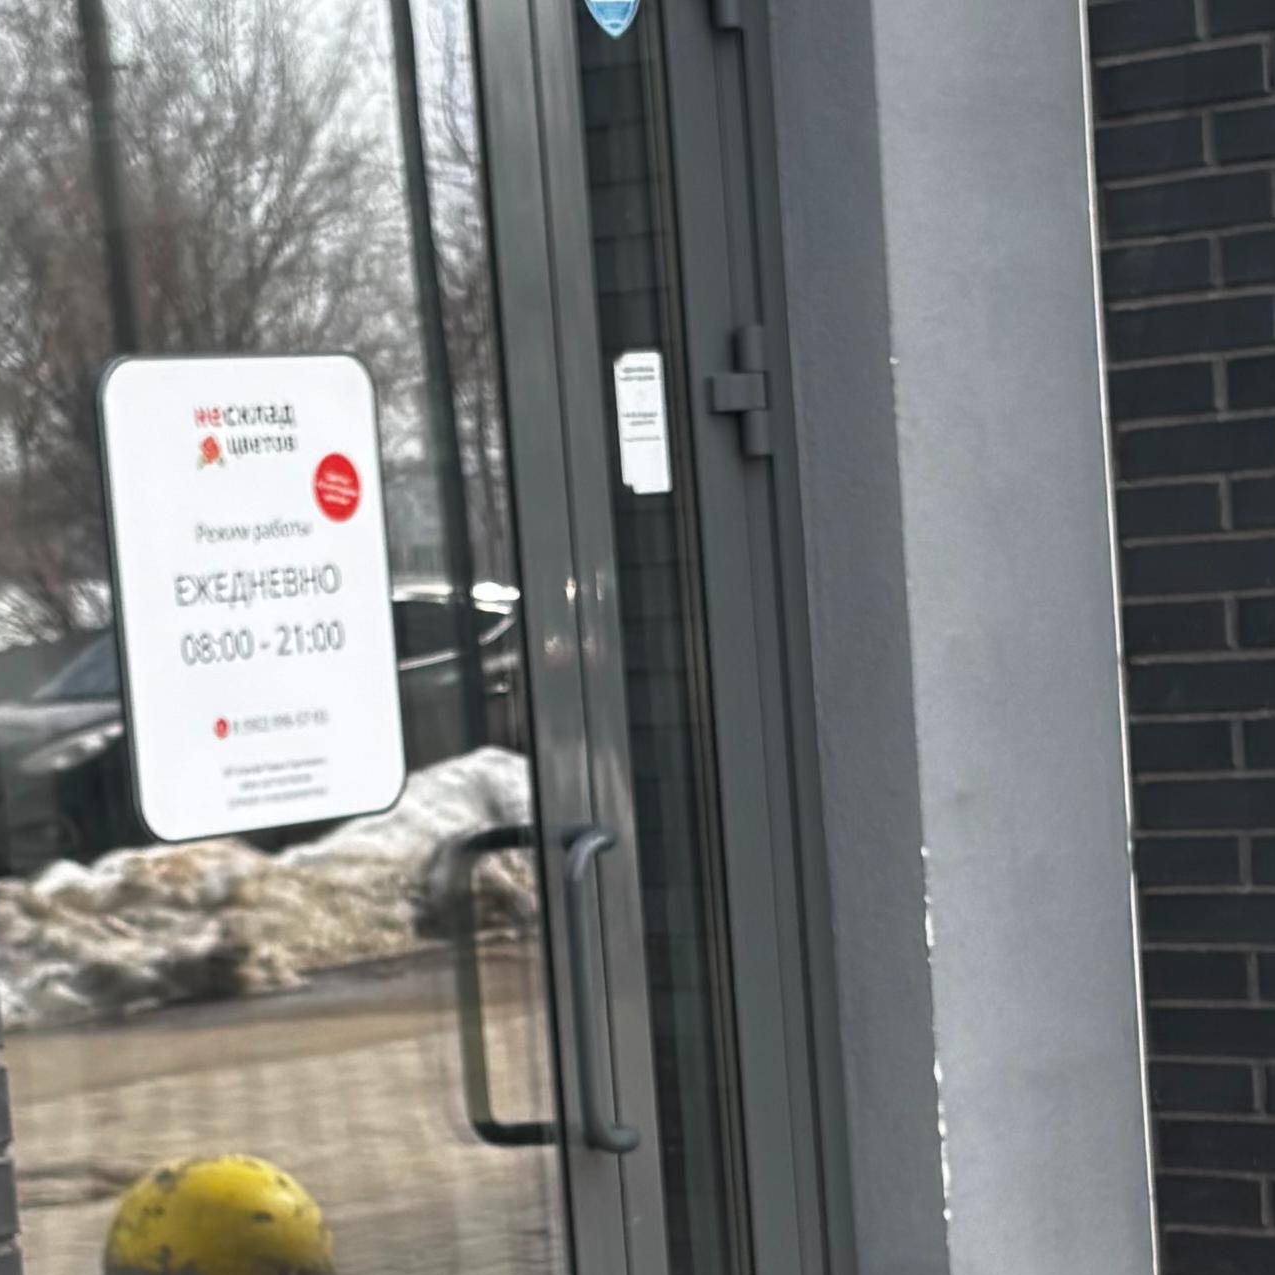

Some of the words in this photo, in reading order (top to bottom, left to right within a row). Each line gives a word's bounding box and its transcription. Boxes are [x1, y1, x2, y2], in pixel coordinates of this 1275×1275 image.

[196, 523, 249, 543] Режим
[252, 518, 313, 545] работы
[175, 564, 342, 608] ЕЖЕДНЕВНО
[181, 629, 255, 665] 08:00
[276, 620, 345, 656] 21:00
